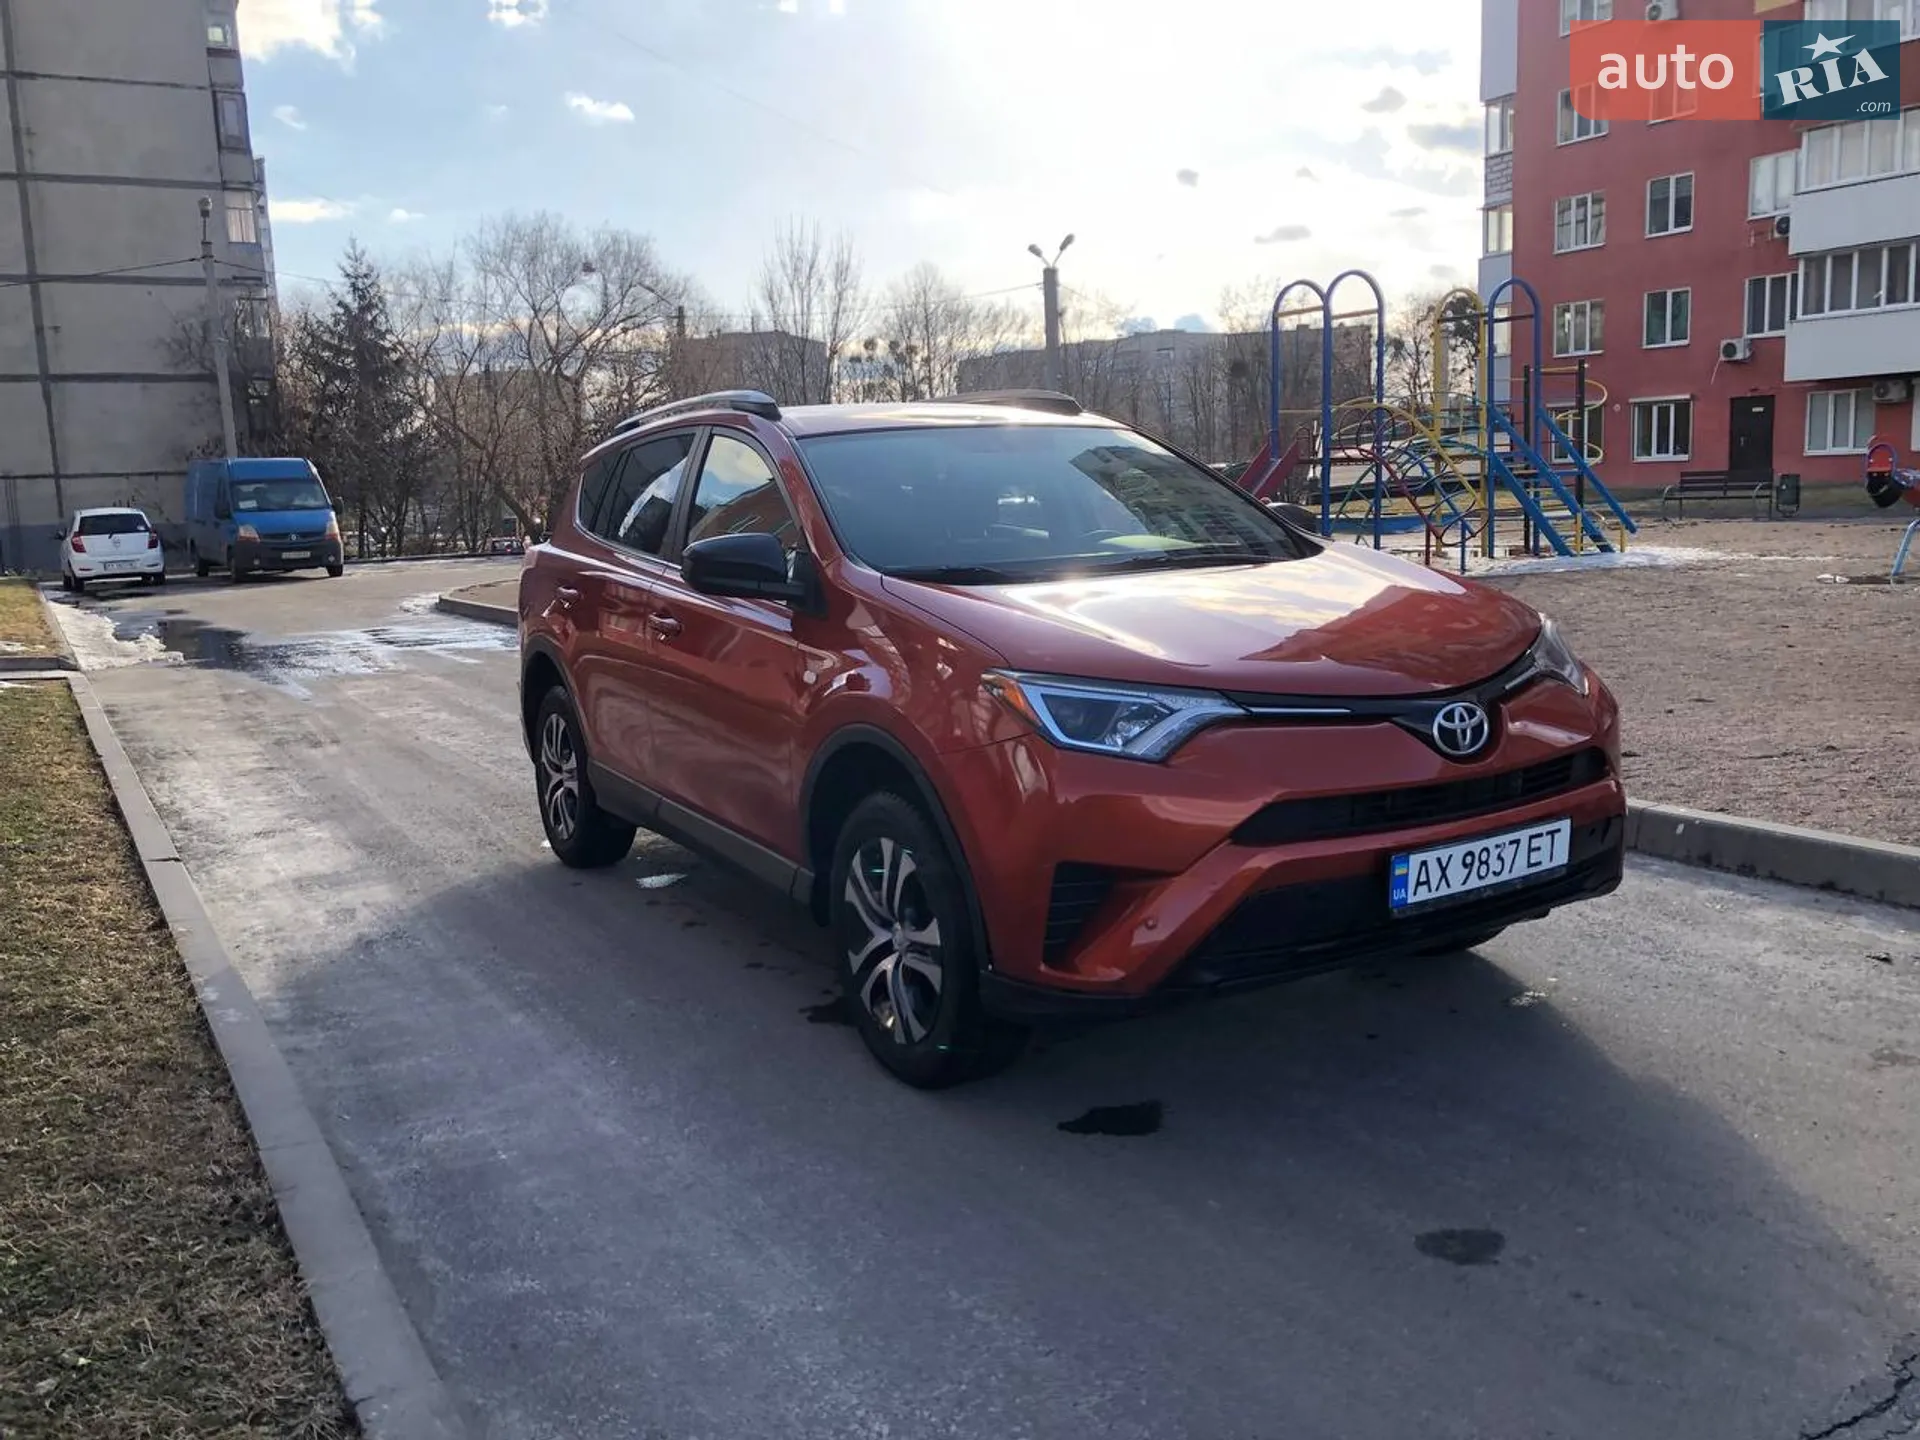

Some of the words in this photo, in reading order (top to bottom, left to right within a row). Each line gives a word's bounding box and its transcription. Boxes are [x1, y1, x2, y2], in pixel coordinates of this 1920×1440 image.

[1413, 854, 1453, 896] AX
[1461, 839, 1521, 886] 9837
[1526, 828, 1561, 868] ET
[1393, 888, 1406, 900] UA
